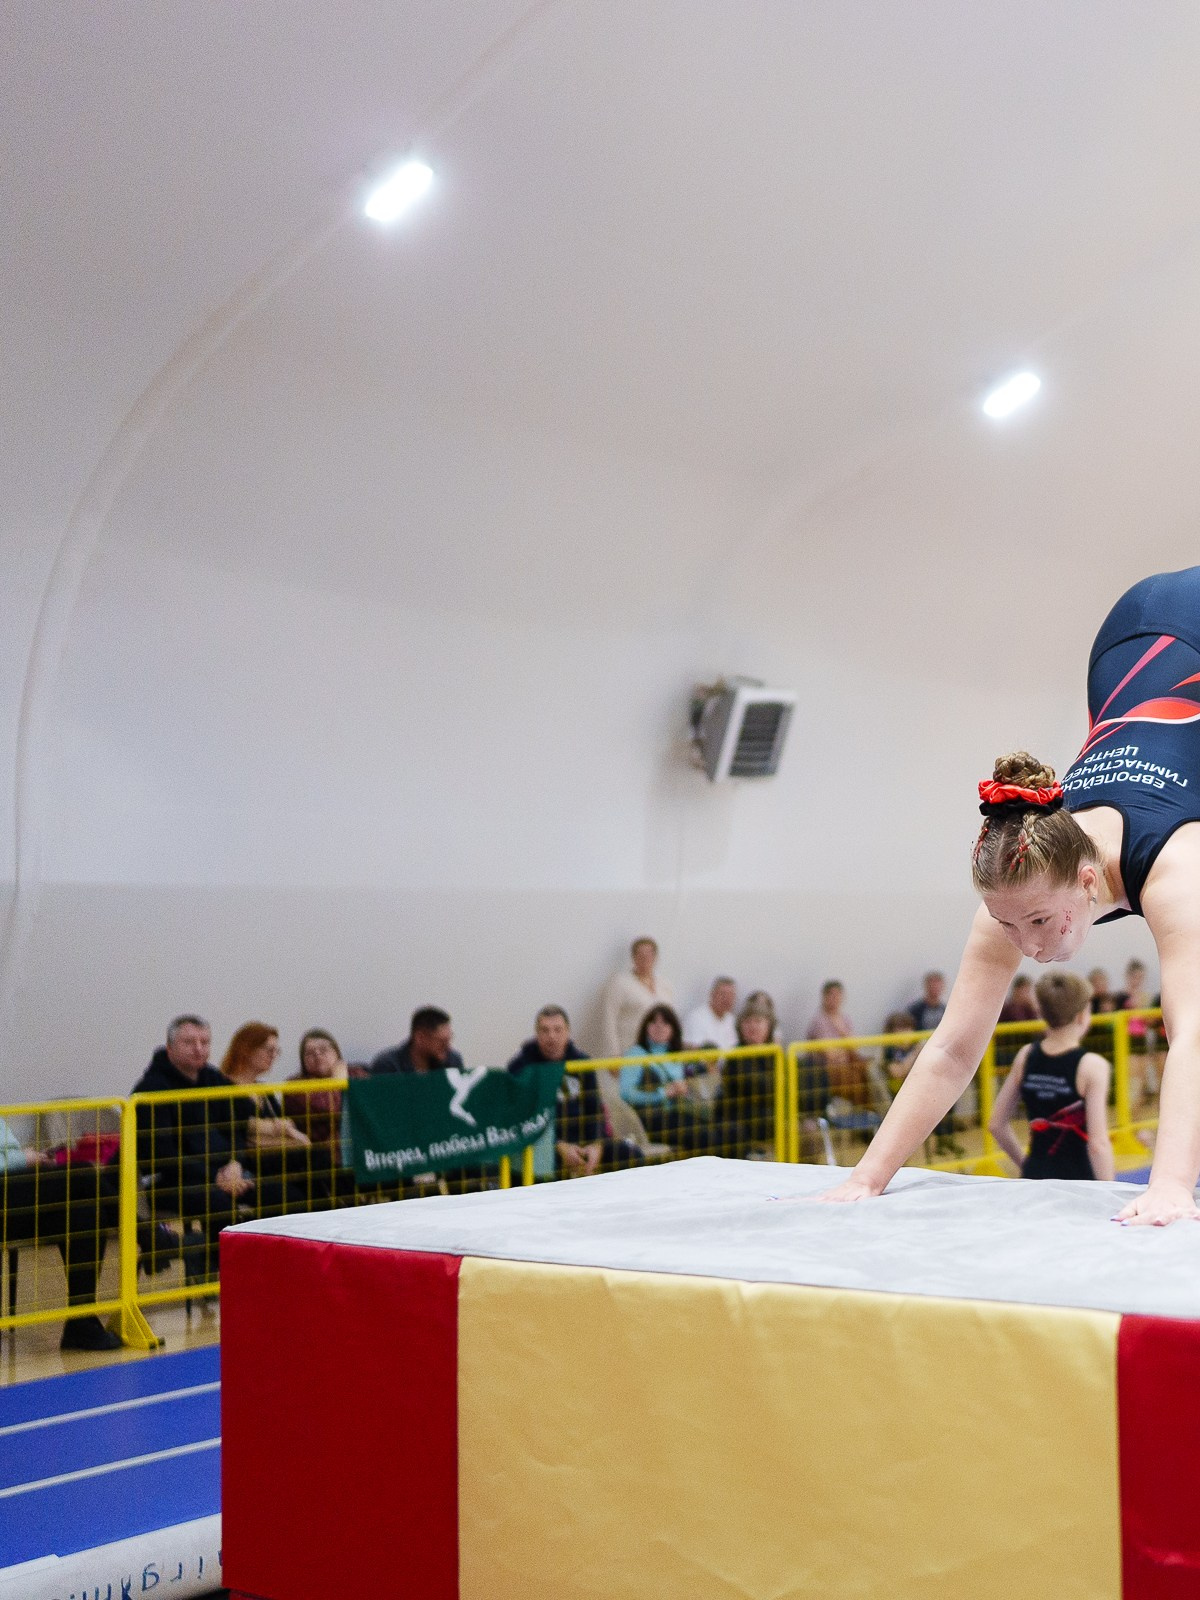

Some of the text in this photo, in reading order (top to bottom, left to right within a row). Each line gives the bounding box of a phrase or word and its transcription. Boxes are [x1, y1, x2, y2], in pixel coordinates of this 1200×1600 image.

[1084, 745, 1139, 764] ЦЕНТР
[1061, 758, 1189, 789] ГИМНАСТИЧЕС
[1061, 771, 1166, 792] ЕВРОПЕЙСК
